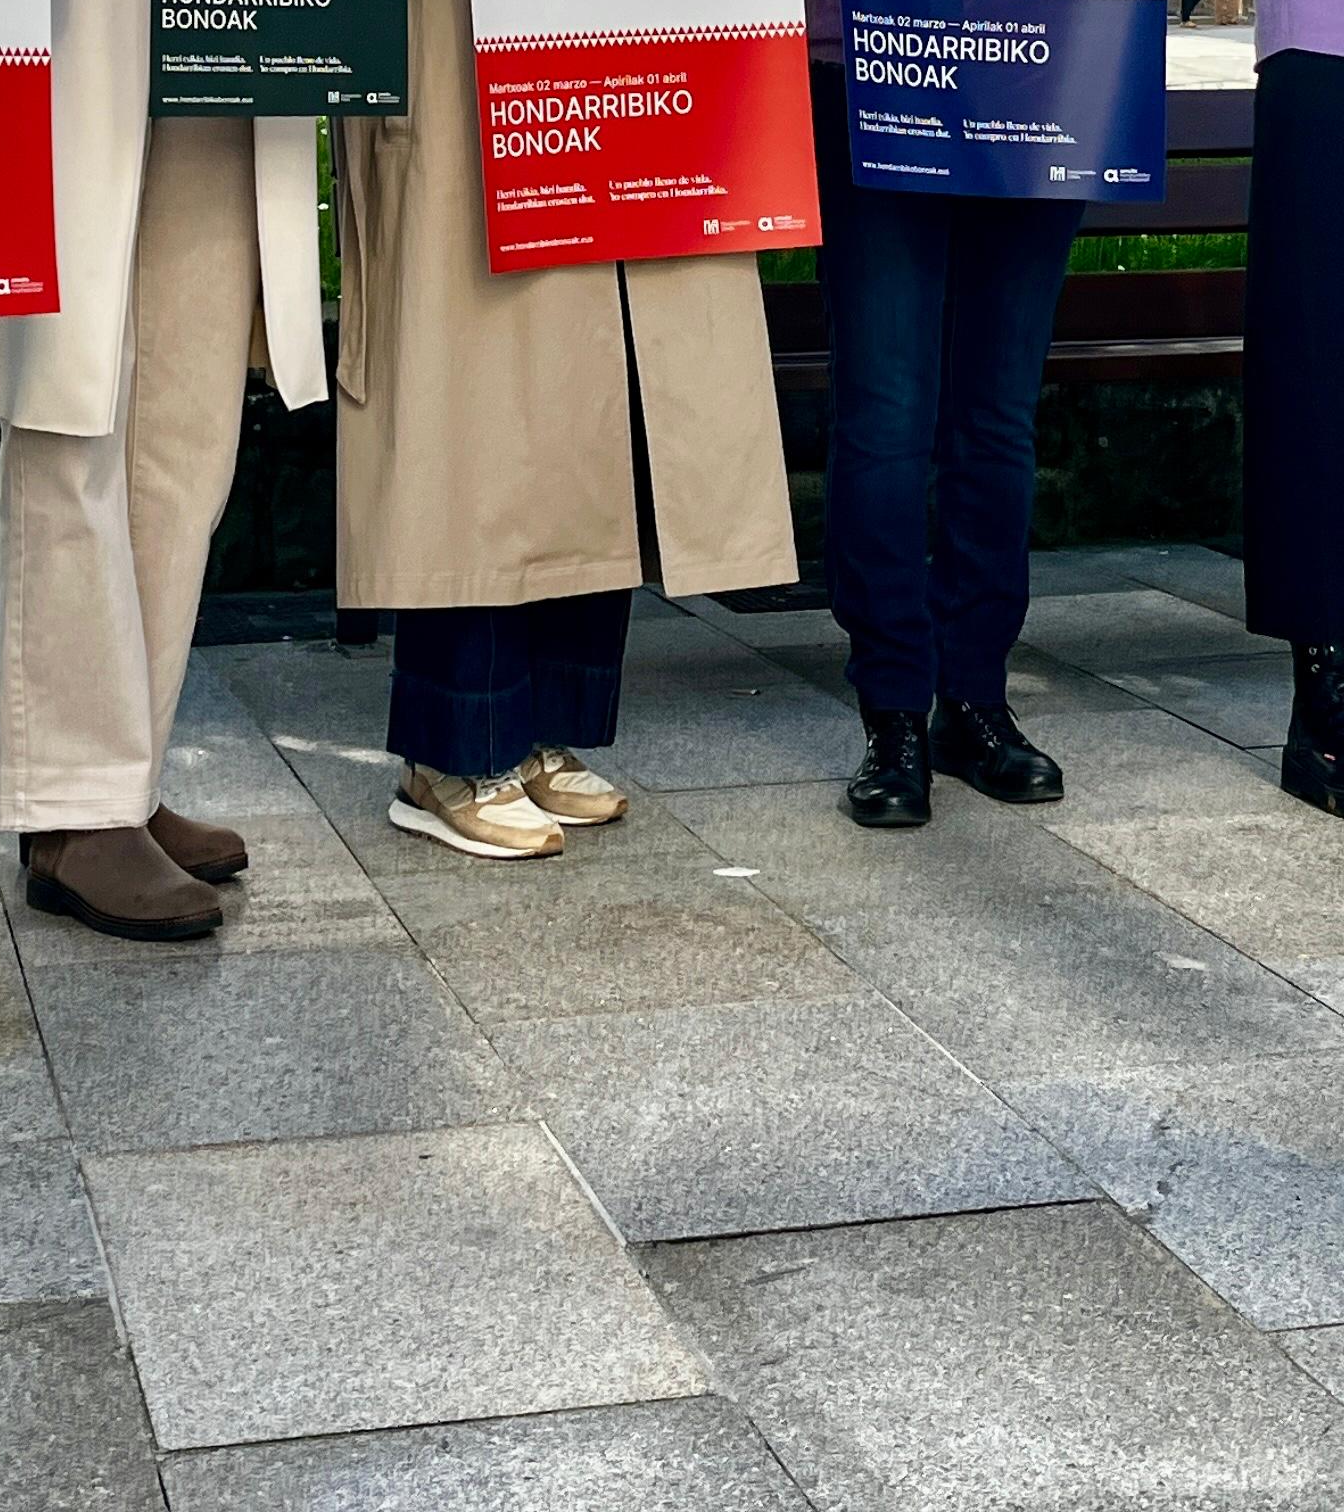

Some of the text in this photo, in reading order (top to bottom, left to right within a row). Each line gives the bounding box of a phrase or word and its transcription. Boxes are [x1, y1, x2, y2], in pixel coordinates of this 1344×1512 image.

[162, 9, 257, 30] BONOAK
[854, 28, 1049, 64] HONDARRIBIKO
[856, 58, 957, 89] BONOAK
[491, 90, 692, 126] HONDARRIBIKO
[493, 126, 601, 158] BONOAK
